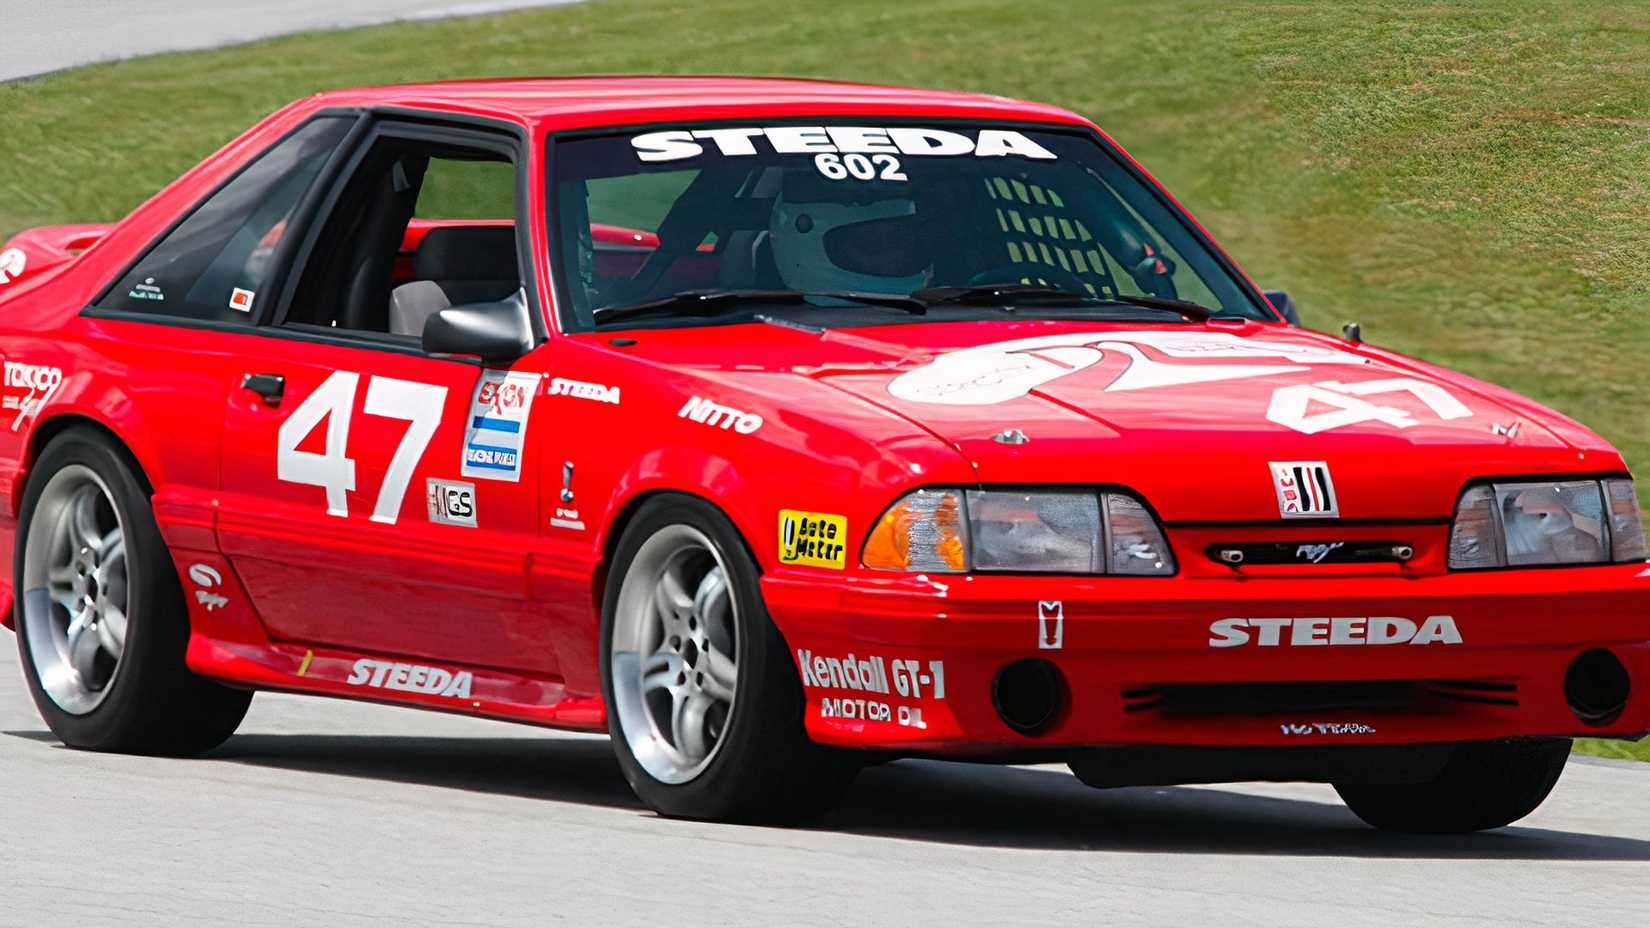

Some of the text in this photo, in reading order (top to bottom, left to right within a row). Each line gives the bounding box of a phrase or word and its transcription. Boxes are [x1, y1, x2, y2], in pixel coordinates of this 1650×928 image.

[631, 126, 1058, 162] STEEDA
[815, 153, 908, 181] 602
[548, 377, 620, 404] STEEDA
[1265, 378, 1474, 435] 47
[677, 396, 764, 434] NITTO
[277, 369, 449, 525] 47
[1208, 615, 1464, 648] STEEDA
[346, 658, 473, 700] STEEDA
[797, 648, 945, 699] Kendall GT-1
